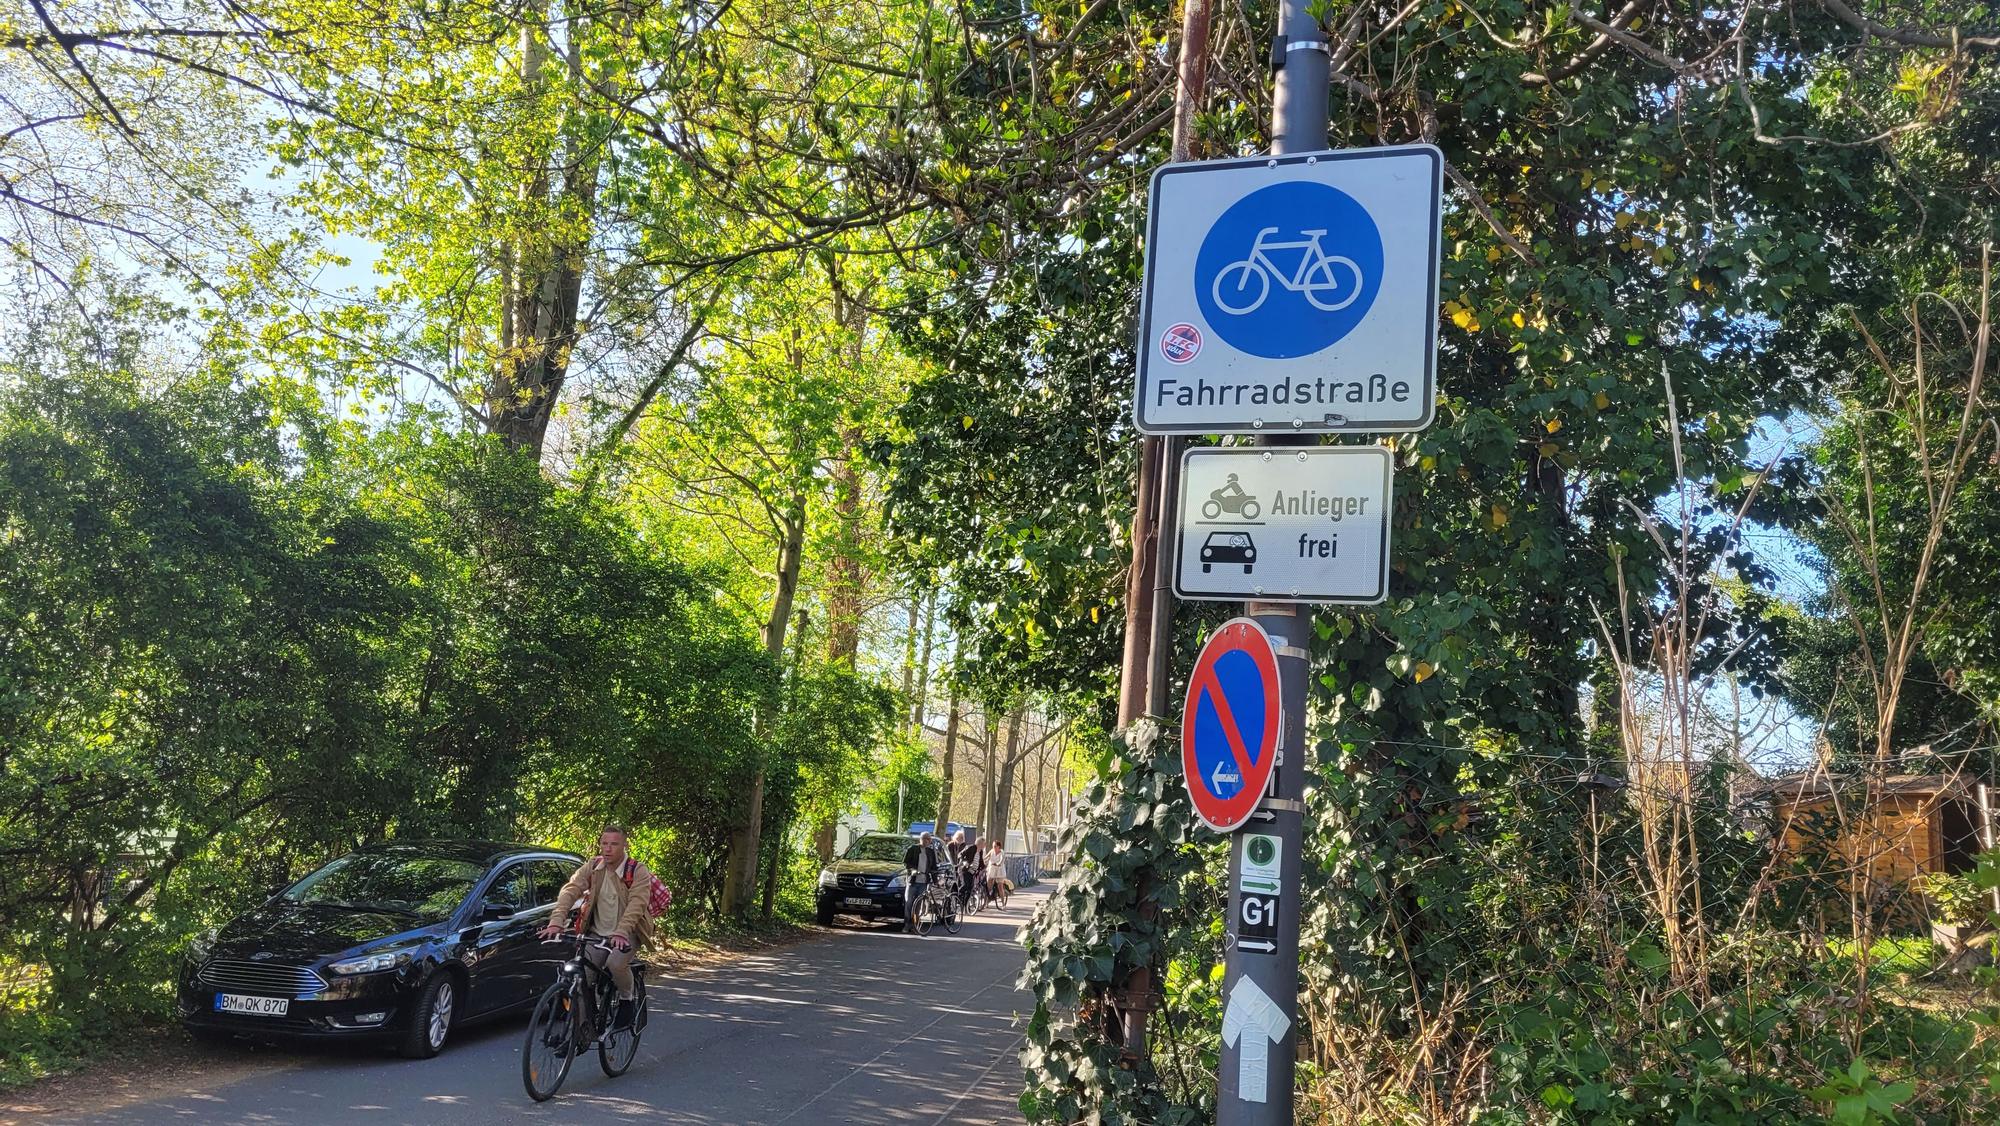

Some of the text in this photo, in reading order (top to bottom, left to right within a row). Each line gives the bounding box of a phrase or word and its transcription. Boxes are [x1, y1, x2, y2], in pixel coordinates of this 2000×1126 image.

[1157, 374, 1410, 407] Fahrradstraße
[1272, 490, 1369, 522] Anlieger
[1298, 533, 1338, 558] frei
[1242, 897, 1275, 927] G1
[222, 995, 287, 1013] BM QK 870
